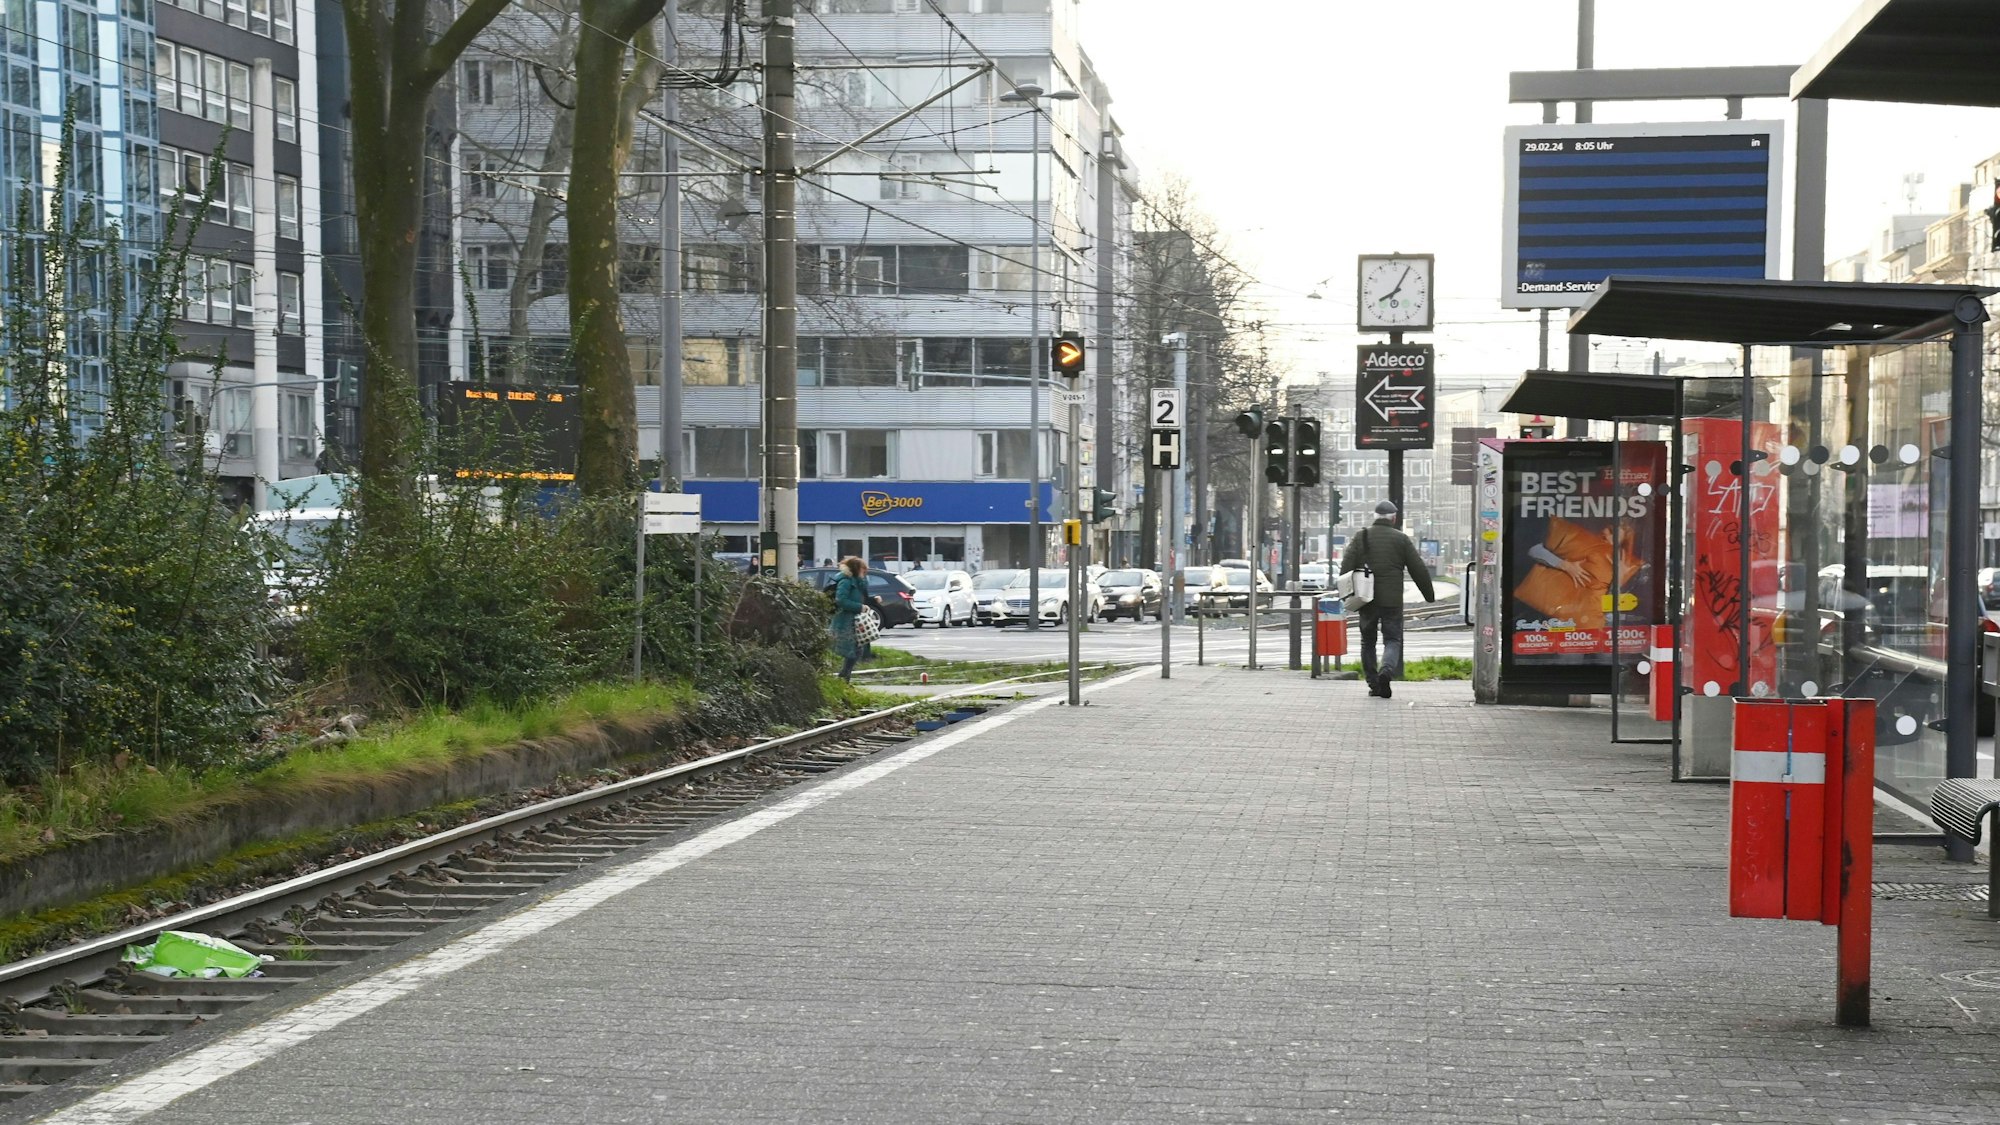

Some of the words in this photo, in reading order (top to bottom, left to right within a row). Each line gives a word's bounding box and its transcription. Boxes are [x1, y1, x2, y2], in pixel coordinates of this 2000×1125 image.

[1525, 142, 1563, 152] 29.02.24
[1575, 141, 1595, 151] 8:05
[1597, 141, 1614, 151] Uhr
[1751, 138, 1761, 148] in
[1365, 352, 1425, 367] Adecco
[1156, 399, 1175, 424] 2
[1152, 434, 1179, 466] H
[1604, 469, 1649, 480] Hffner
[1521, 471, 1596, 495] BEST
[1524, 634, 1548, 643] 100€
[1564, 631, 1593, 641] 500€
[1559, 640, 1598, 648] GESCHENKT
